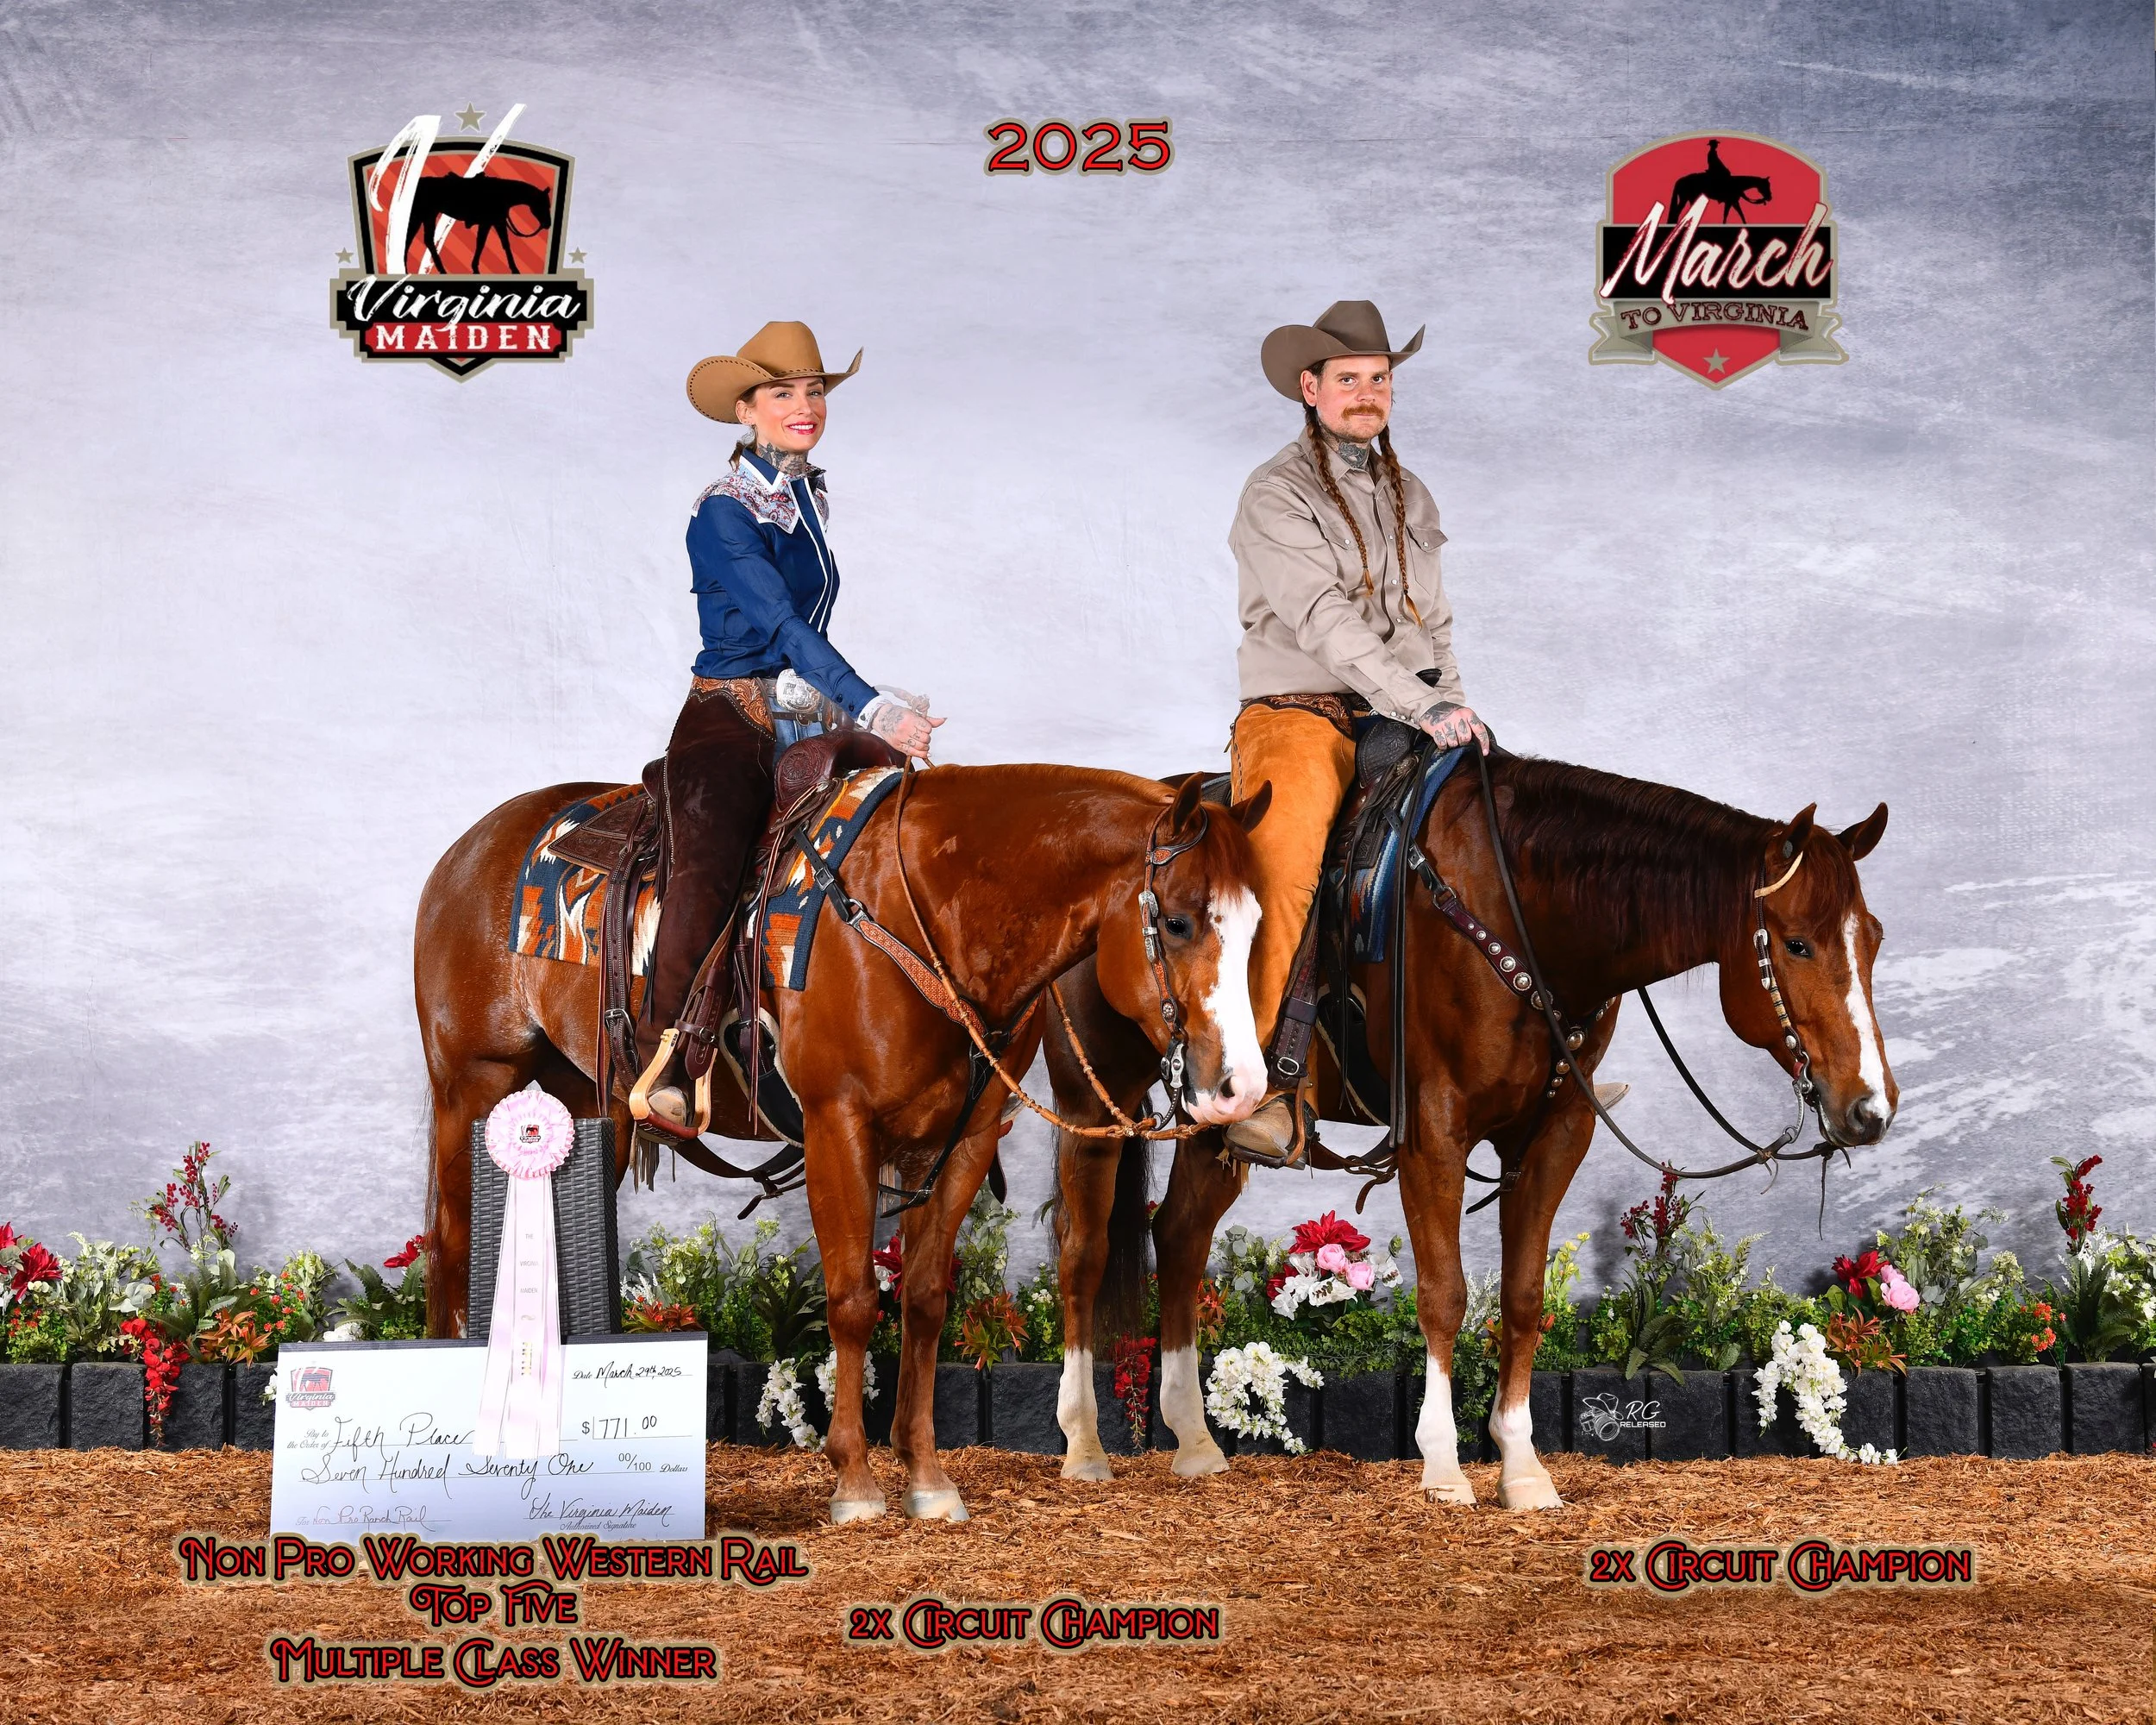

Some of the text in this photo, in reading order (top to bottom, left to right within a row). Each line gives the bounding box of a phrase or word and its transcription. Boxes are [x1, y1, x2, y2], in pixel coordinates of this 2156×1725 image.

[572, 1371, 592, 1379] Date
[596, 1361, 634, 1388] March
[657, 1366, 682, 1377] 2025
[304, 1428, 329, 1440] Pay to
[581, 1421, 591, 1435] $
[328, 1412, 475, 1462] Fifth Place
[286, 1440, 332, 1450] the Order of
[659, 1463, 689, 1473] Dollars
[301, 1451, 594, 1500] Seven Hundred Seventy One
[530, 1492, 672, 1527] The Virginia Maiden
[395, 1505, 436, 1532] Rail
[560, 1521, 637, 1532] Authorized Signature
